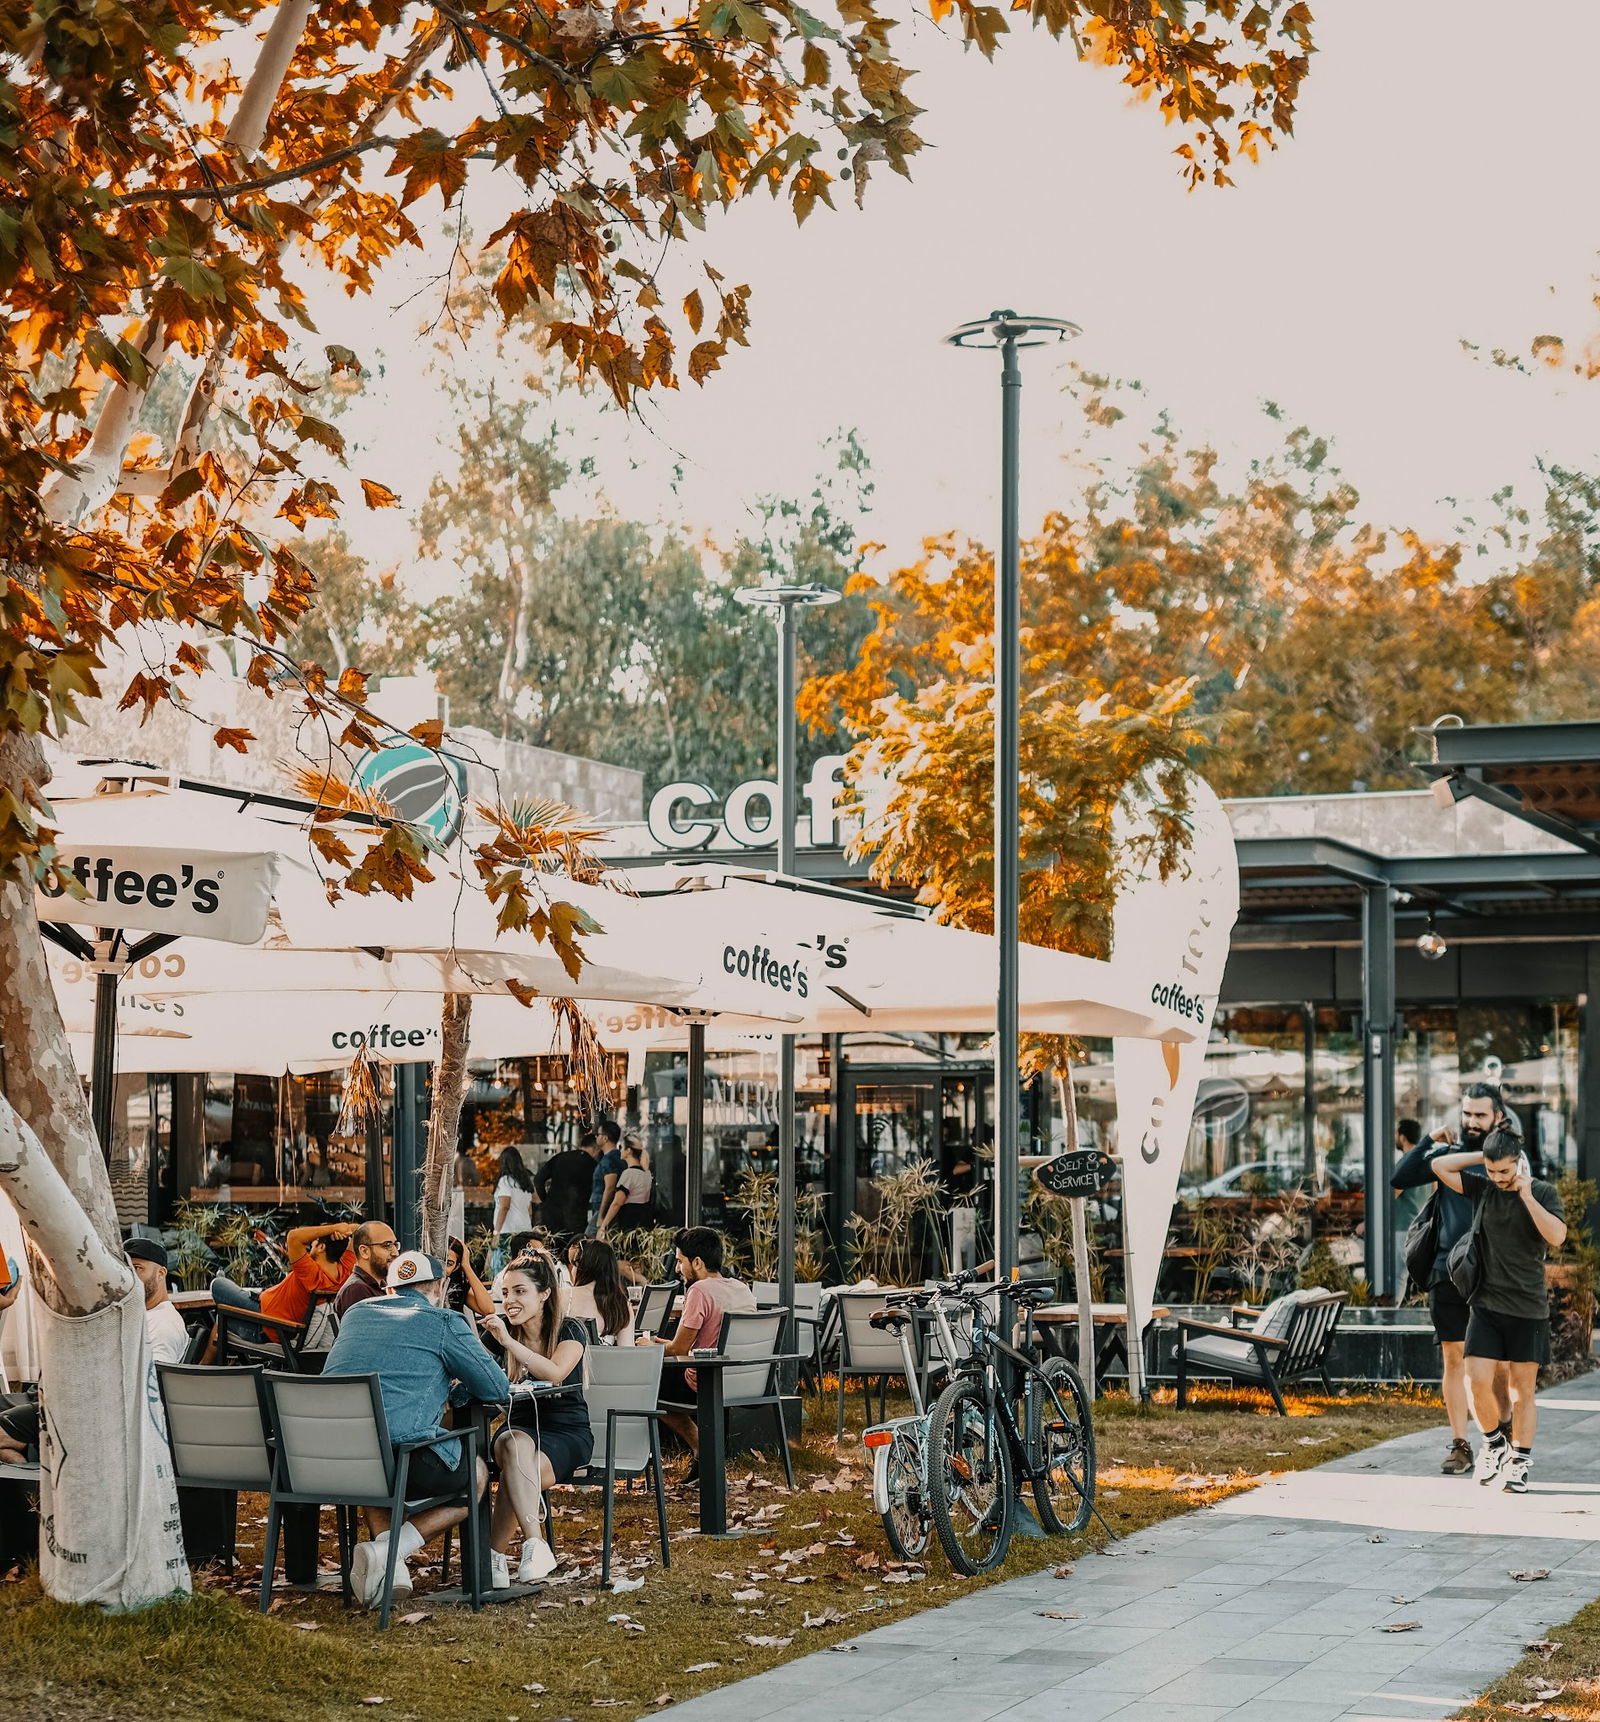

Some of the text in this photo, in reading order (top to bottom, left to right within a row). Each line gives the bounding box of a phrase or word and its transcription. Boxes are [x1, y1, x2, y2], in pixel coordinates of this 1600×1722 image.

[37, 856, 220, 914] offee's
[723, 944, 808, 998] coffee's
[1151, 983, 1204, 1024] coffee's
[331, 1023, 439, 1050] coffee'
[1055, 1157, 1085, 1173] SELF
